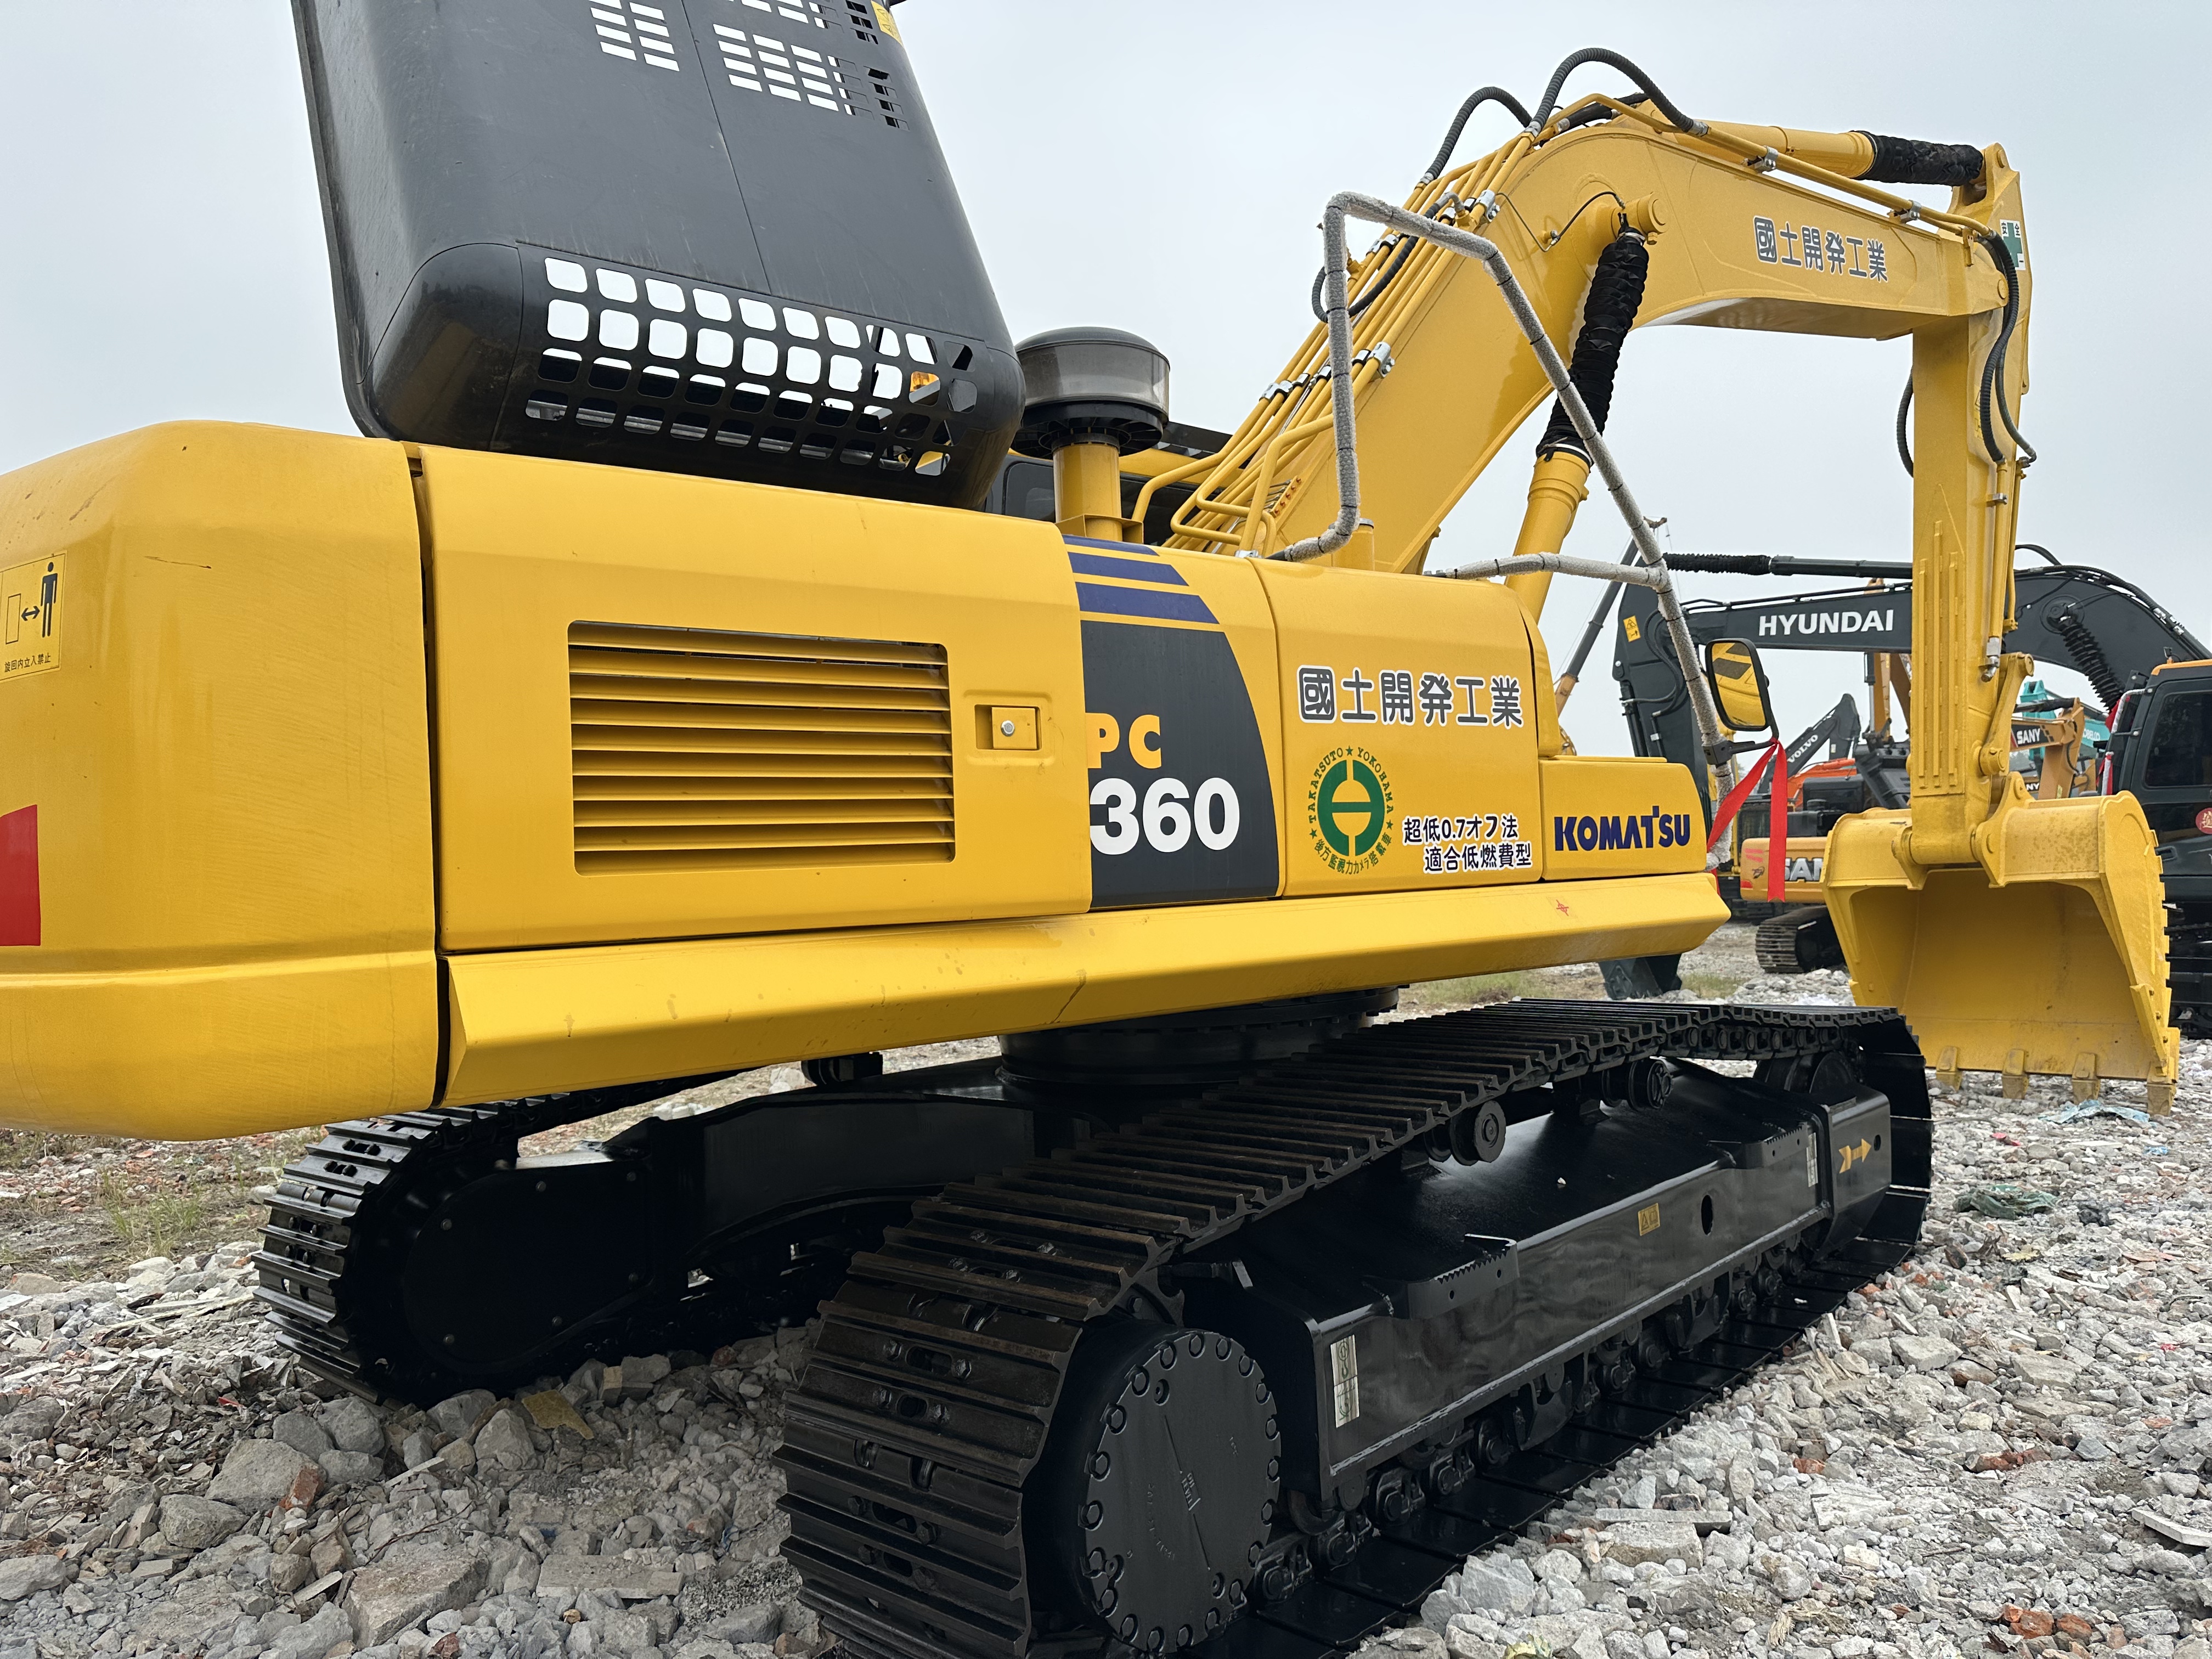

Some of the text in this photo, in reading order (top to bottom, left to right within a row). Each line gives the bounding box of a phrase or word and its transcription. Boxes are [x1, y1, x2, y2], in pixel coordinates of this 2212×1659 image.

[1758, 609, 1894, 637] HYUNDAI
[1086, 712, 1162, 769] PC
[1787, 734, 1819, 763] VOLVO
[2016, 727, 2041, 745] SANY
[1308, 747, 1394, 824] TAKATSUTO YOKOHAMA
[1090, 777, 1240, 855] 360
[1554, 805, 1691, 851] KOMATSU
[1425, 842, 1532, 872] 適合低燃費型
